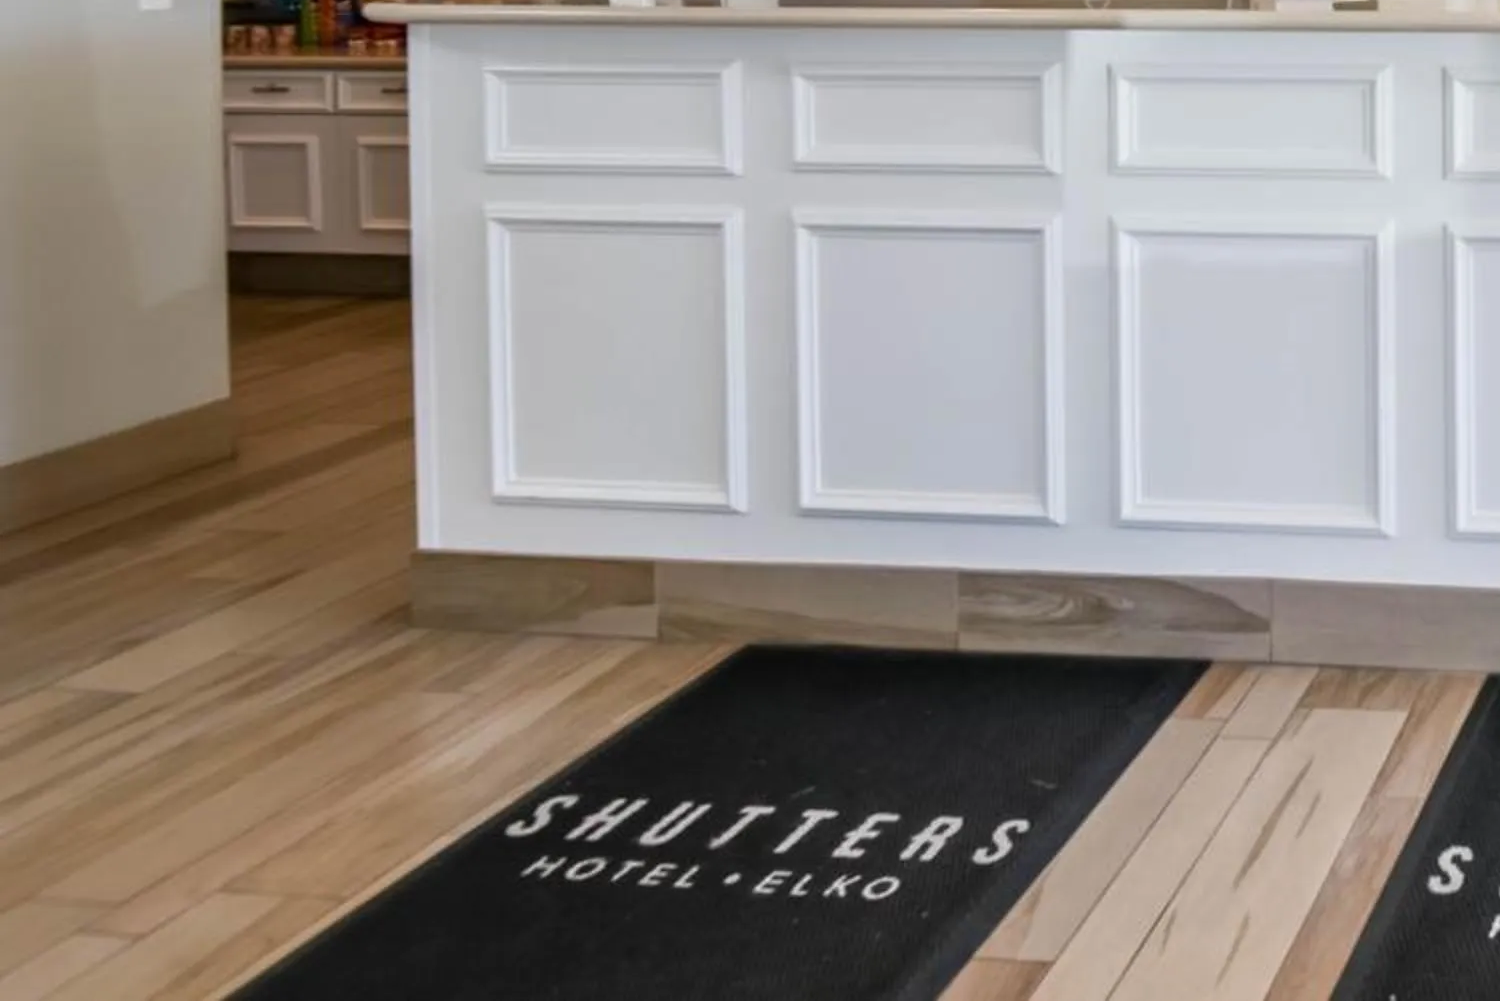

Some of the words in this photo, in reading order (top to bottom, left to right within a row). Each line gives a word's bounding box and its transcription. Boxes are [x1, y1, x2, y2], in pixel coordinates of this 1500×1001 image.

[506, 795, 1030, 864] SHUTTERS
[519, 855, 699, 888] HOTEL
[753, 870, 901, 900] ELKO
